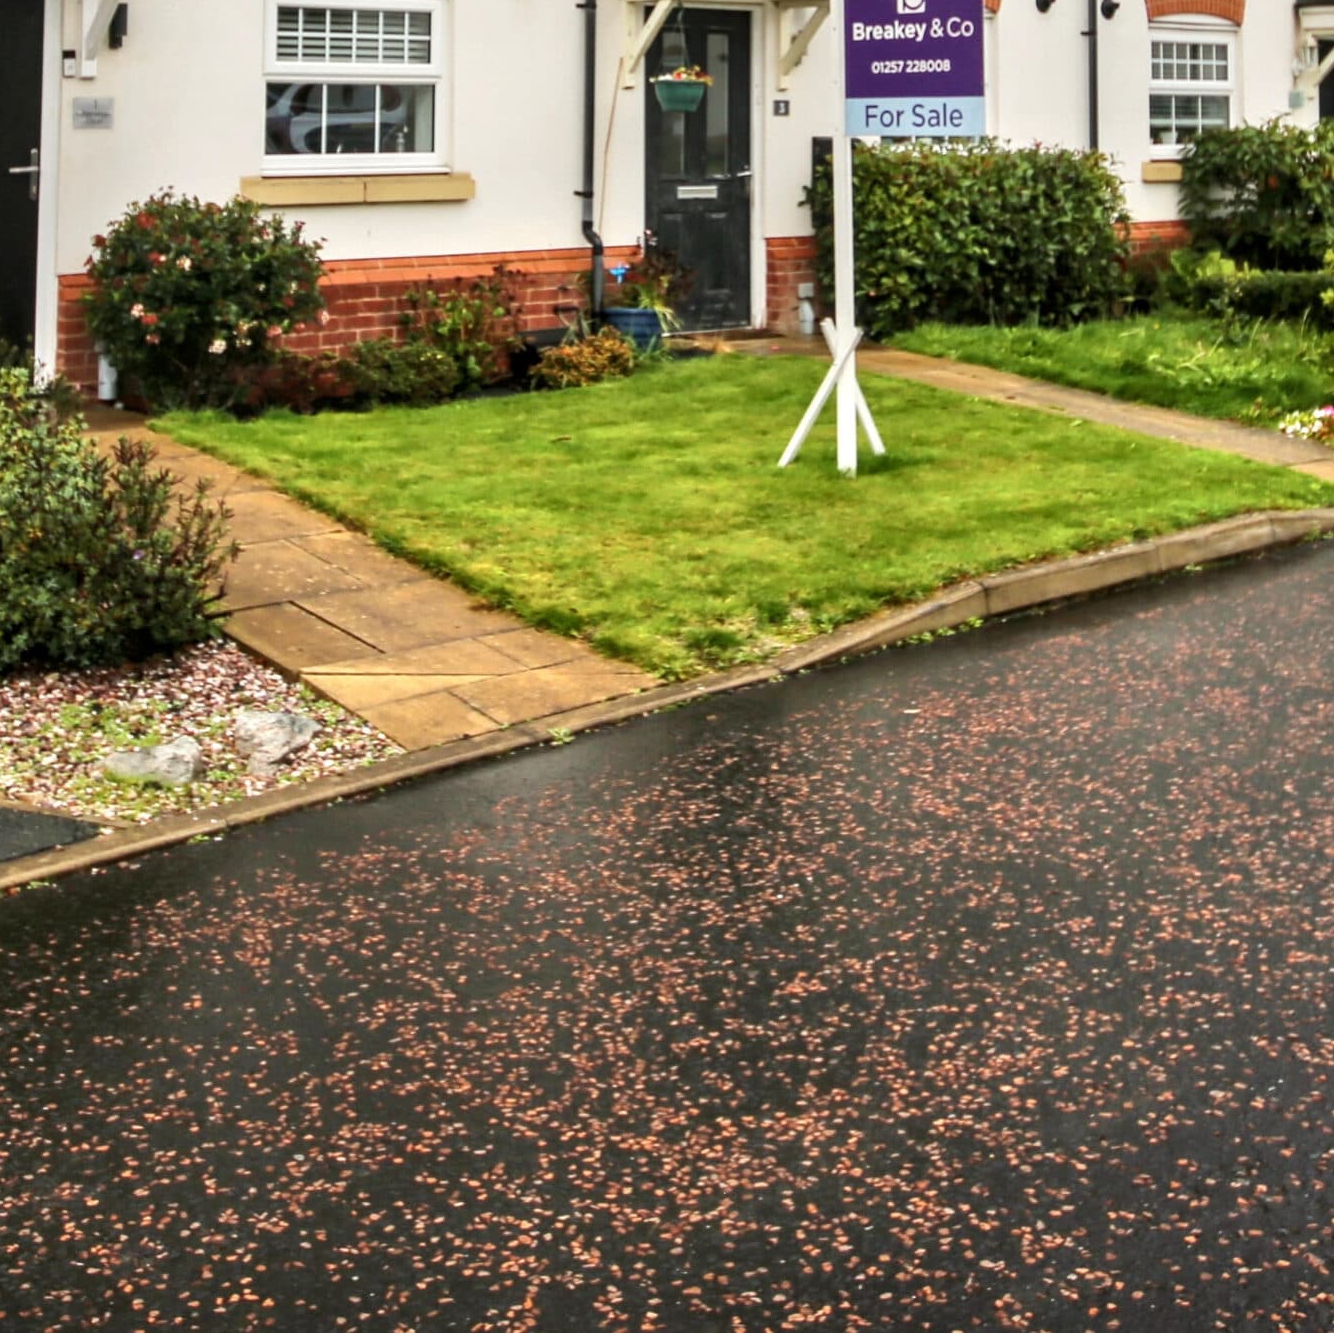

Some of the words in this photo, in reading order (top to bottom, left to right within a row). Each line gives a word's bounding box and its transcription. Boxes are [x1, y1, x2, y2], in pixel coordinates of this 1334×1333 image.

[852, 20, 927, 43] Breakey
[930, 18, 944, 38] &
[946, 16, 974, 38] Co
[871, 60, 904, 74] 01257
[905, 58, 951, 73] 228008
[865, 104, 904, 128] For
[911, 102, 963, 128] Sale
